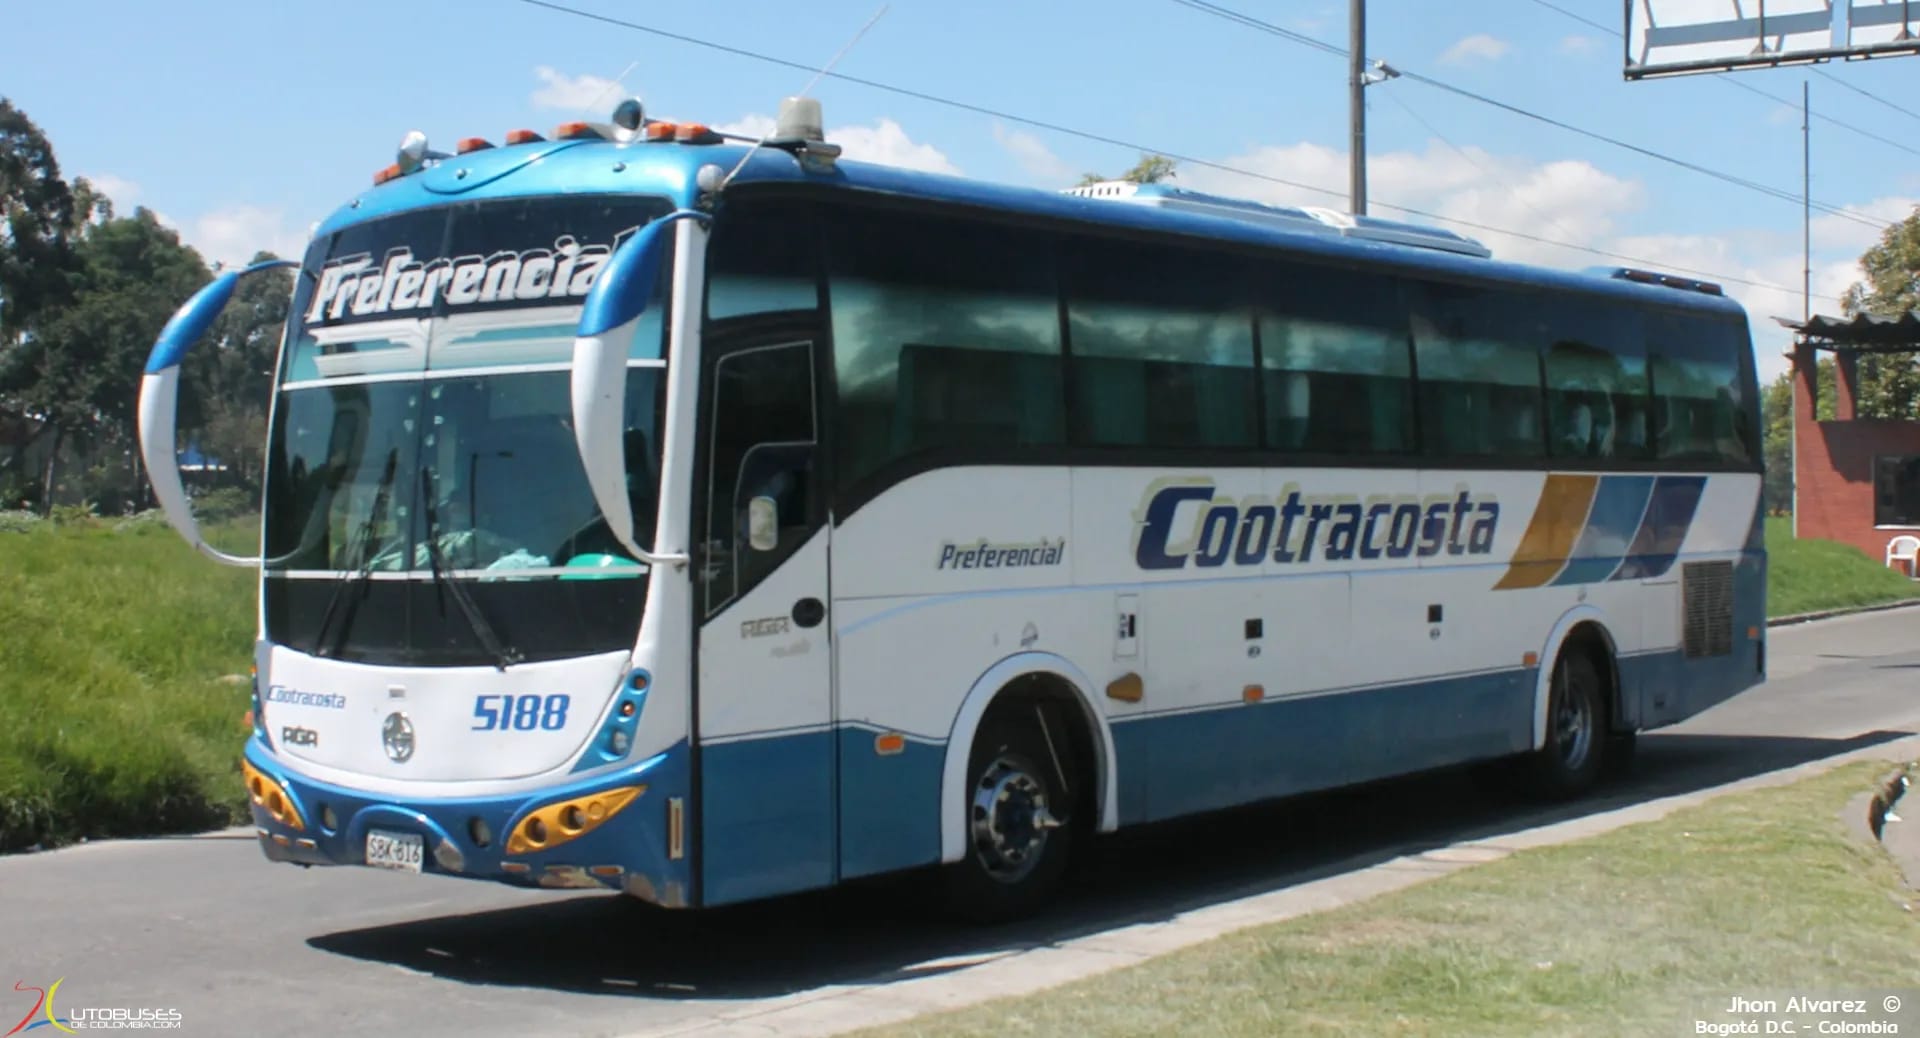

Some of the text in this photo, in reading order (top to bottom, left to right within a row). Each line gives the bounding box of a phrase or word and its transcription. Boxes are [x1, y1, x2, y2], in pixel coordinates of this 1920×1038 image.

[304, 227, 638, 324] Preferencia
[1133, 478, 1500, 570] Cootracosta
[938, 538, 1064, 570] Preferencial
[266, 685, 346, 709] Cootracosta
[471, 694, 570, 730] 5188
